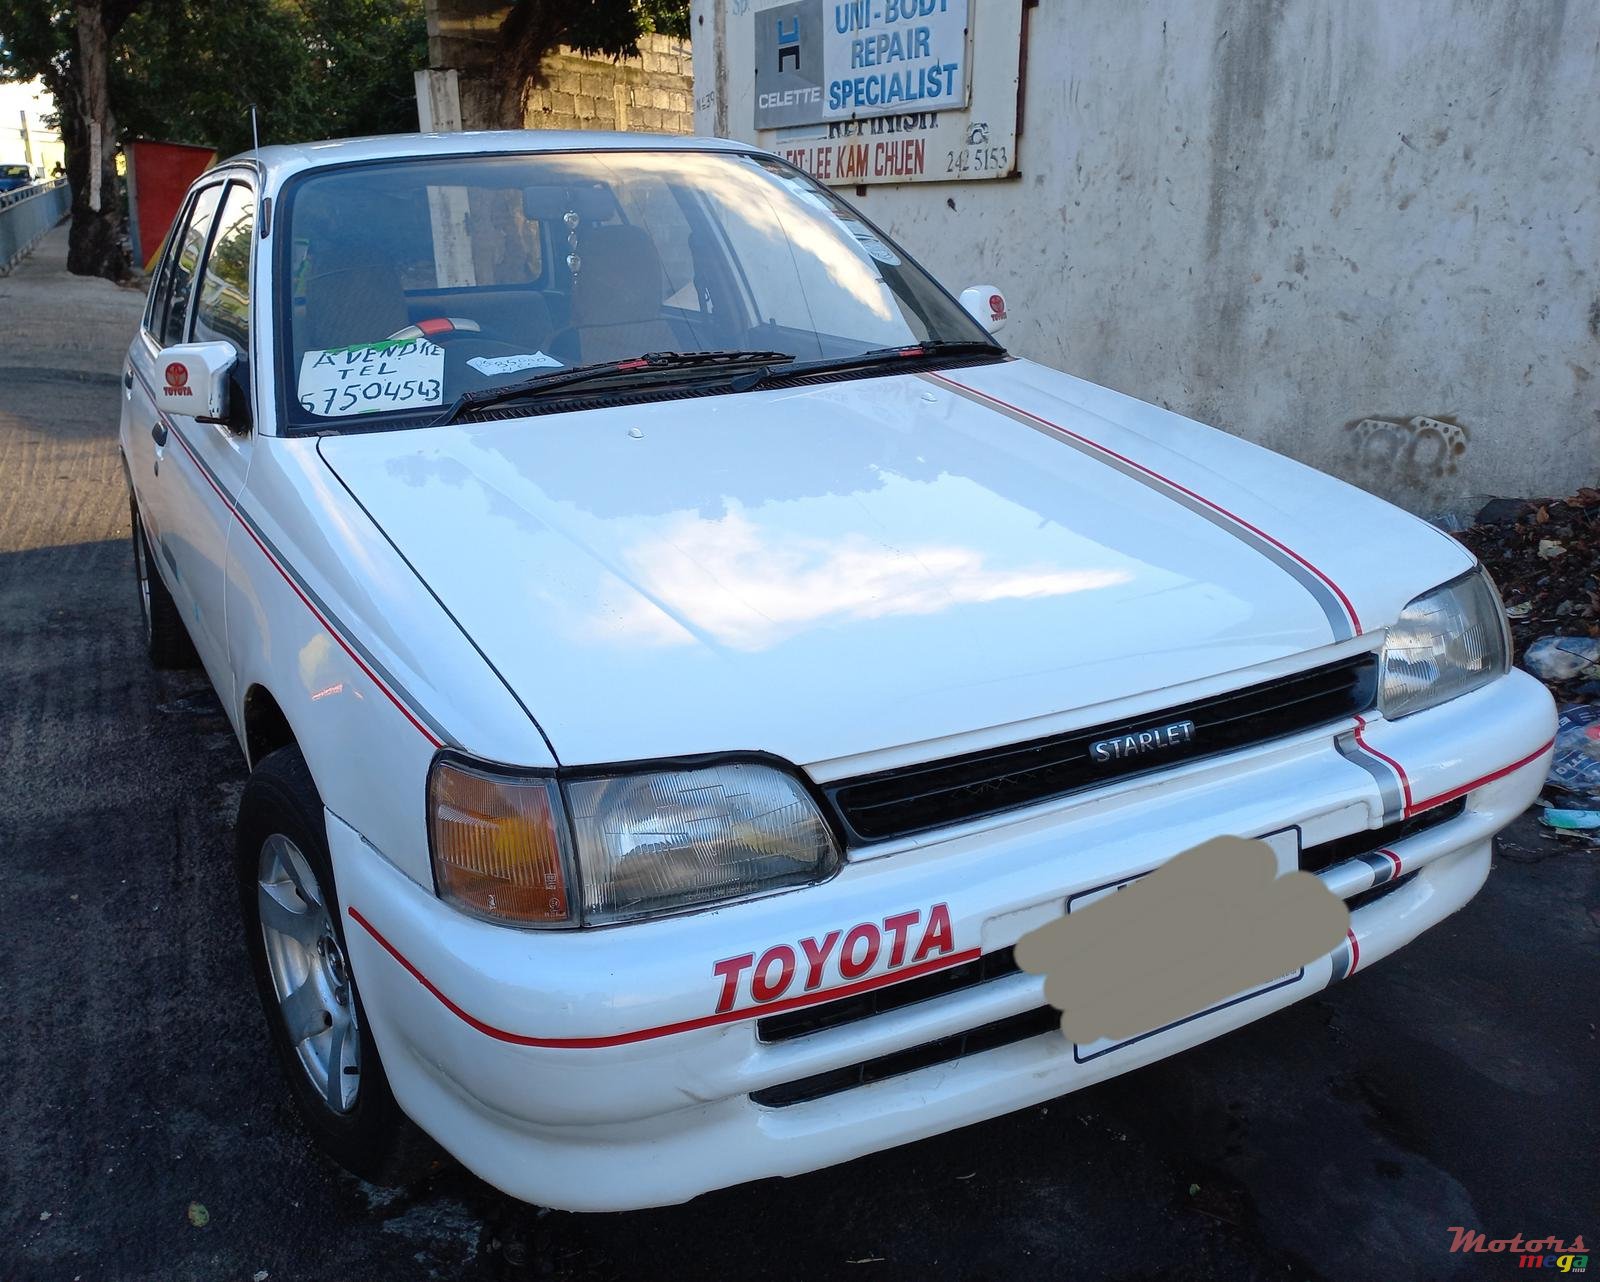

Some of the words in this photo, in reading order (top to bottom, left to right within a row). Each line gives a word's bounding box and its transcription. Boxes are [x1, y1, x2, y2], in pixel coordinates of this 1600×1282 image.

[851, 26, 930, 69] REPAIR
[759, 87, 822, 109] CELETTE
[829, 63, 958, 110] SPECIALIST
[836, 144, 869, 179] KAM
[874, 139, 926, 177] CHUEN
[946, 149, 970, 172] 242
[974, 147, 1008, 171] 5153
[346, 341, 441, 365] VENDRE
[337, 362, 398, 380] TEL
[163, 386, 193, 396] TOYOTA
[1095, 722, 1191, 762] STARLET
[713, 902, 955, 1014] TOYOTA
